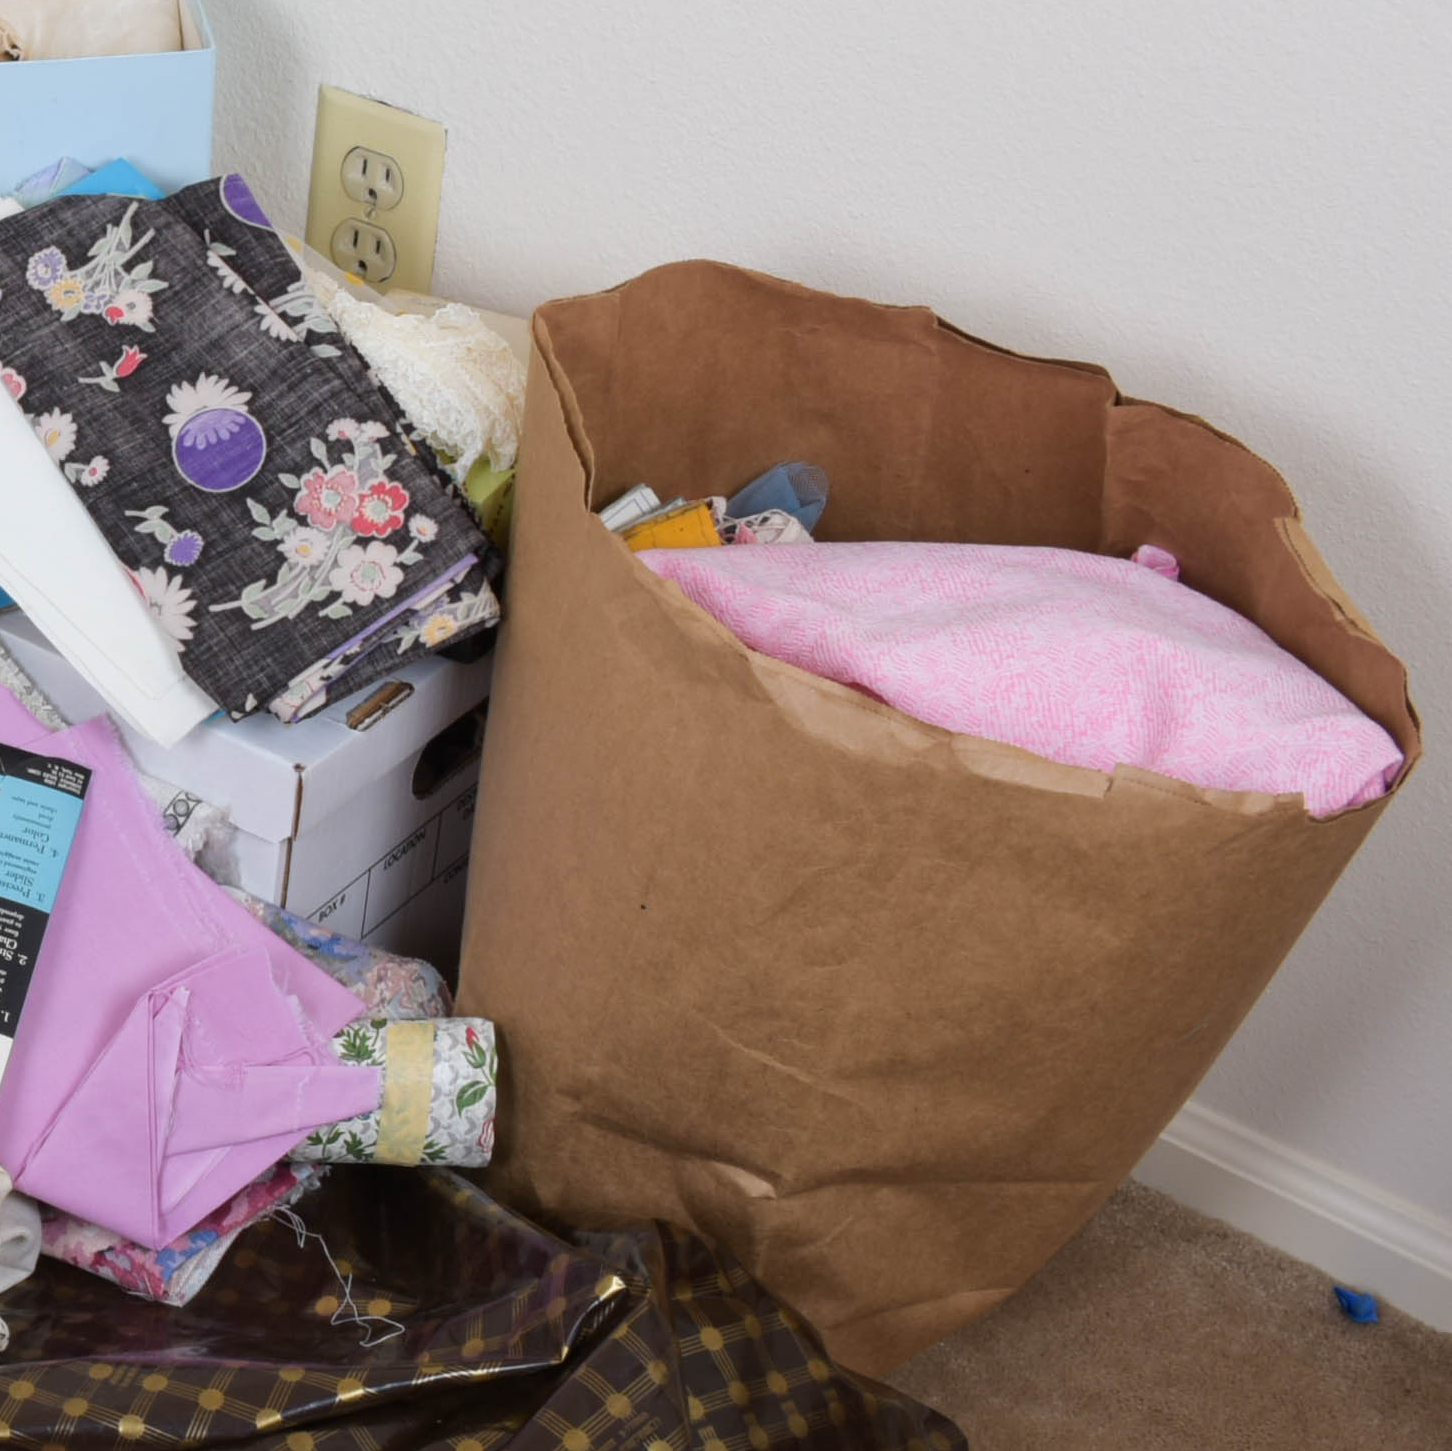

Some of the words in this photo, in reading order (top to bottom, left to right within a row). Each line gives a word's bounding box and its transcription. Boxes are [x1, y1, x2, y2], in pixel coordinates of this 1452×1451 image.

[23, 827, 50, 844] Color
[49, 848, 59, 859] 4.
[382, 827, 427, 871] LOCATION
[4, 870, 35, 888] Slider
[318, 899, 339, 923] BOX
[17, 953, 29, 966] 2.
[0, 1009, 11, 1023] 1.
